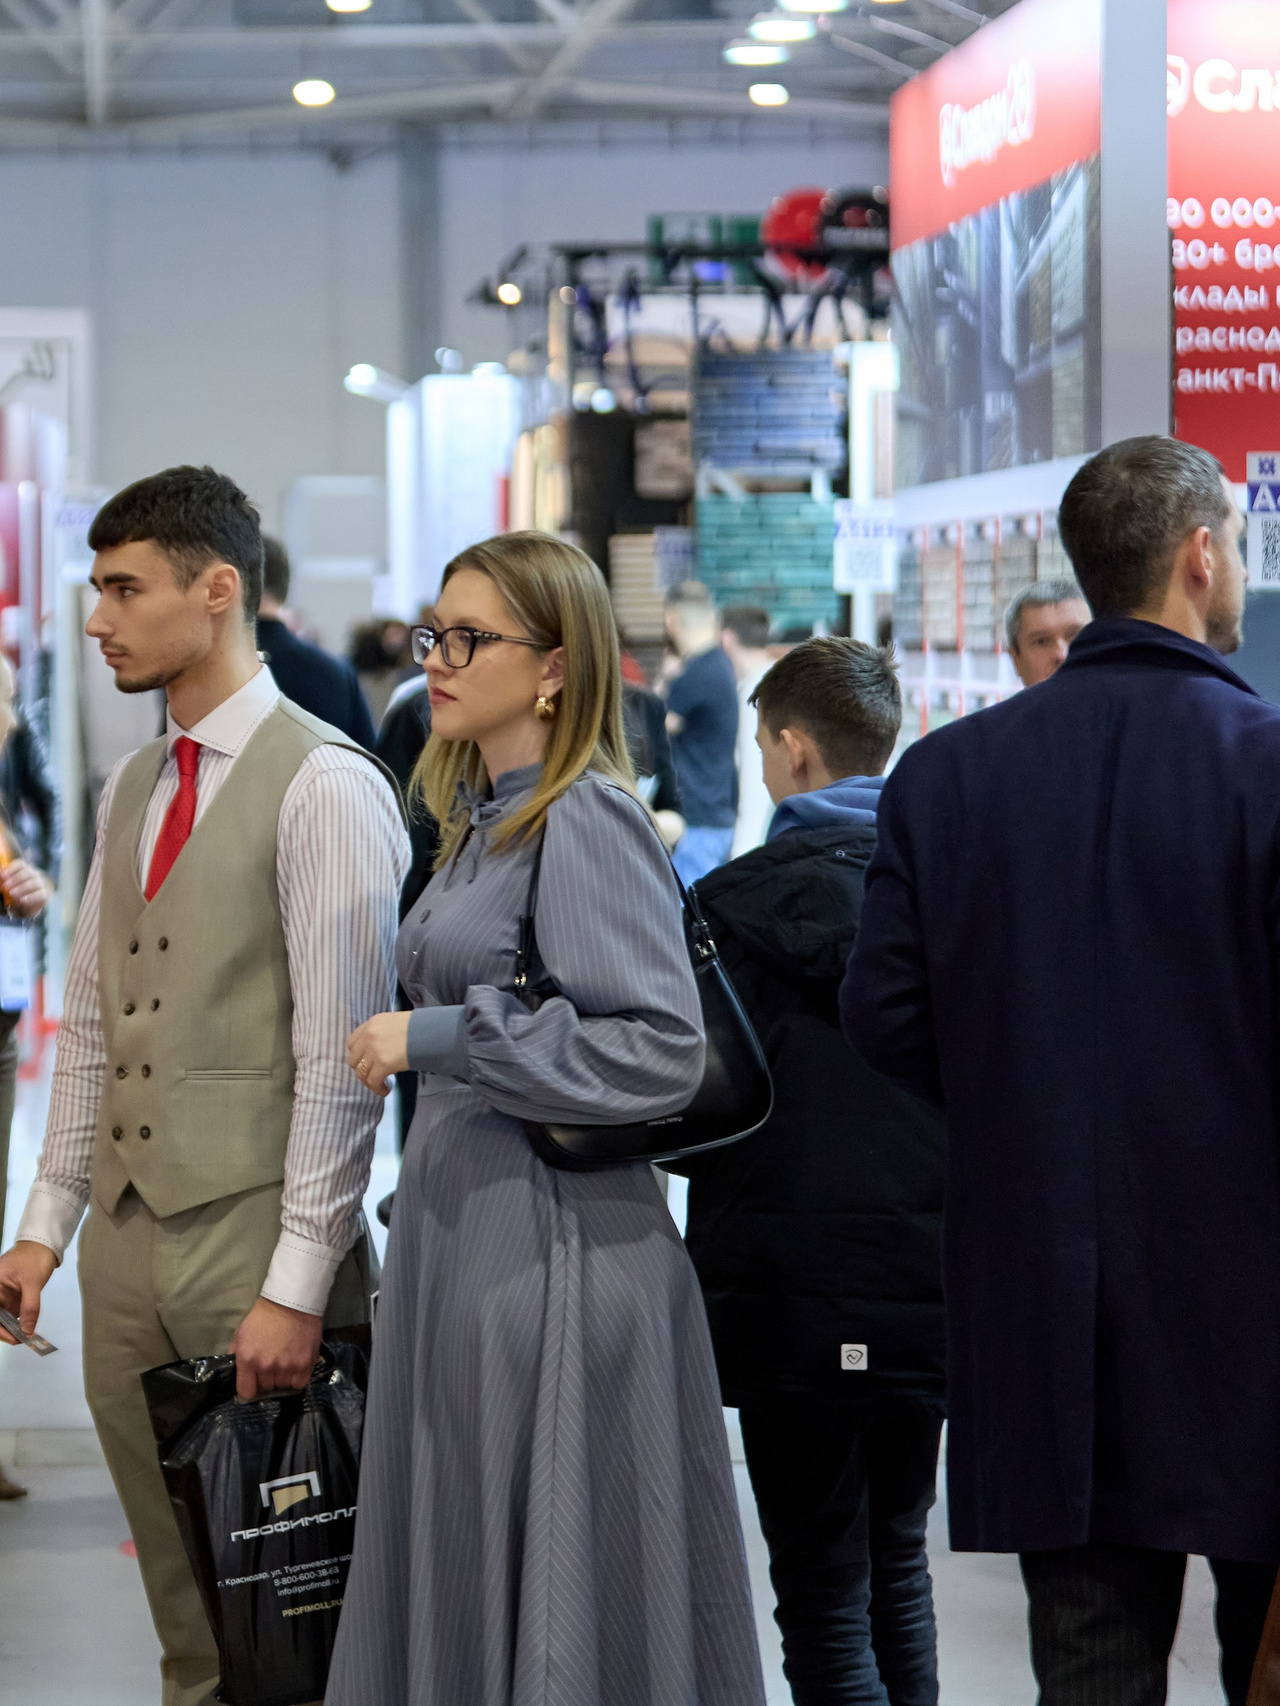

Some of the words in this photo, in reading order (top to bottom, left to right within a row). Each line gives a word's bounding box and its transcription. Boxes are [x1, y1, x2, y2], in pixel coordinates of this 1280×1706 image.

[1193, 58, 1280, 113] Сл
[1211, 197, 1280, 229] 000
[1173, 363, 1280, 394] анкт-П
[339, 1554, 352, 1562] шо
